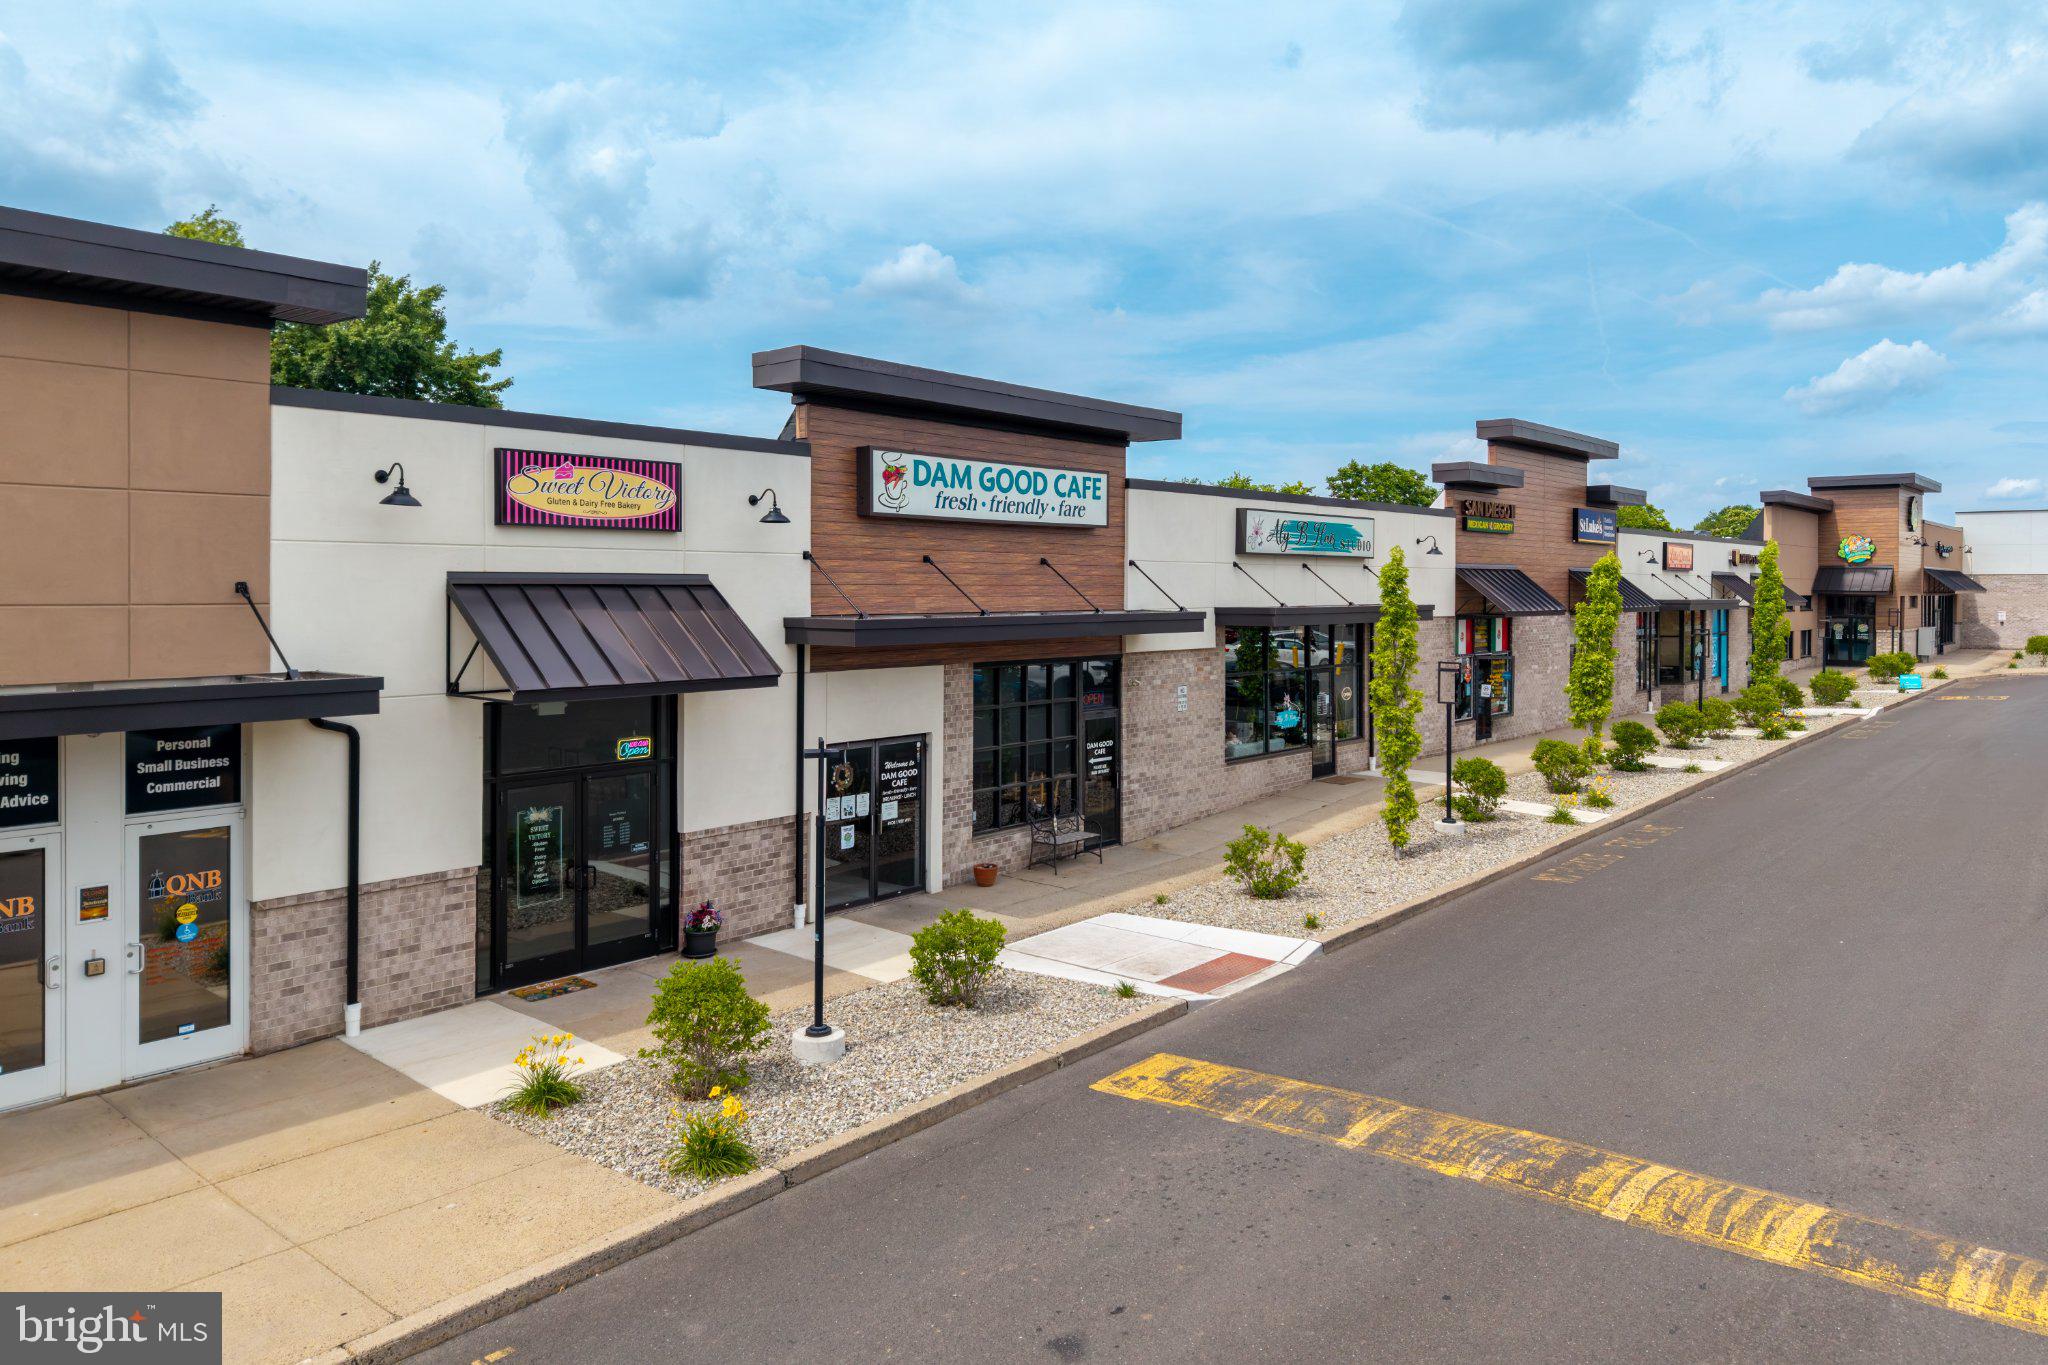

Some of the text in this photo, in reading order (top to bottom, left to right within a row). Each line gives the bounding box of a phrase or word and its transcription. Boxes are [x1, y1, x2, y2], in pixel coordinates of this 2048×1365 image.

[507, 465, 675, 508] Sweet Victory
[913, 459, 1101, 500] DAM GOOD CAFE
[547, 497, 570, 506] Gluten
[580, 499, 599, 508] Dairy
[600, 500, 616, 508] Free
[617, 501, 641, 510] Bakery
[934, 491, 1086, 519] fresh friendly fare
[1465, 499, 1484, 516] SAN
[1295, 520, 1309, 546] B
[1340, 539, 1371, 552] STUDIO
[1083, 693, 1103, 705] OPEN
[157, 737, 211, 751] Personal
[620, 742, 649, 759] Open
[1099, 740, 1113, 748] GOOD
[137, 756, 230, 775] Small Business
[884, 761, 909, 769] Welcome
[881, 768, 918, 780] DAM GOOD
[892, 778, 908, 787] CAFE
[147, 776, 221, 794] Commercial
[0, 793, 49, 808] Advice
[166, 869, 222, 896] QNB
[188, 890, 222, 903] Bank
[0, 896, 35, 918] NB
